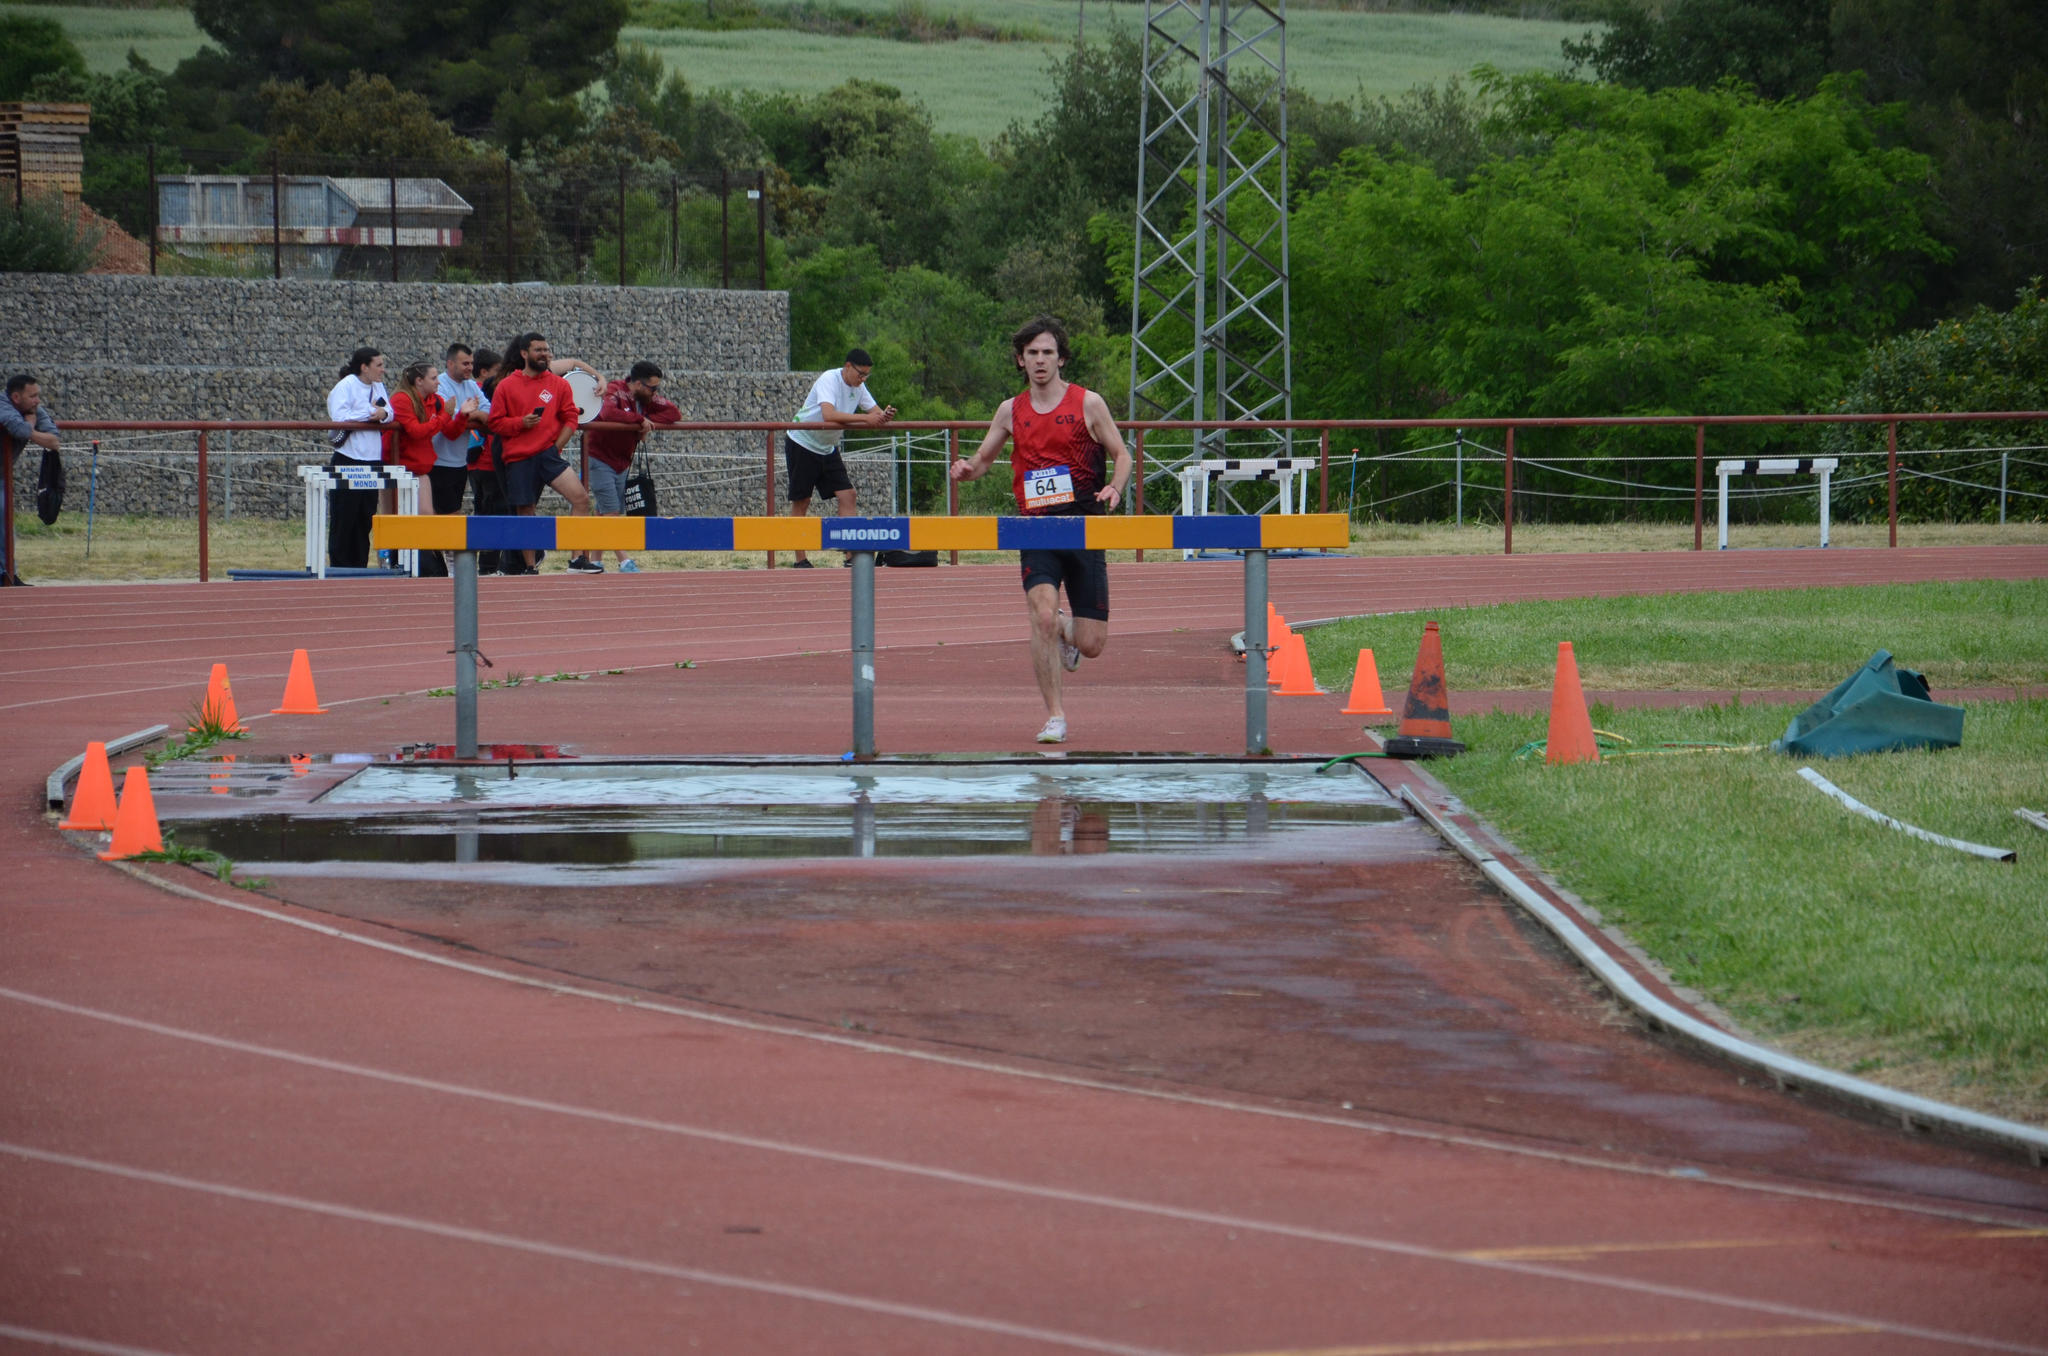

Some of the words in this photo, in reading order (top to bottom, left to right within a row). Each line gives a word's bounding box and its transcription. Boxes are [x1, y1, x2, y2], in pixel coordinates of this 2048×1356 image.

[353, 480, 378, 488] MONDO
[1035, 478, 1057, 496] 64
[841, 528, 901, 541] MONDO
